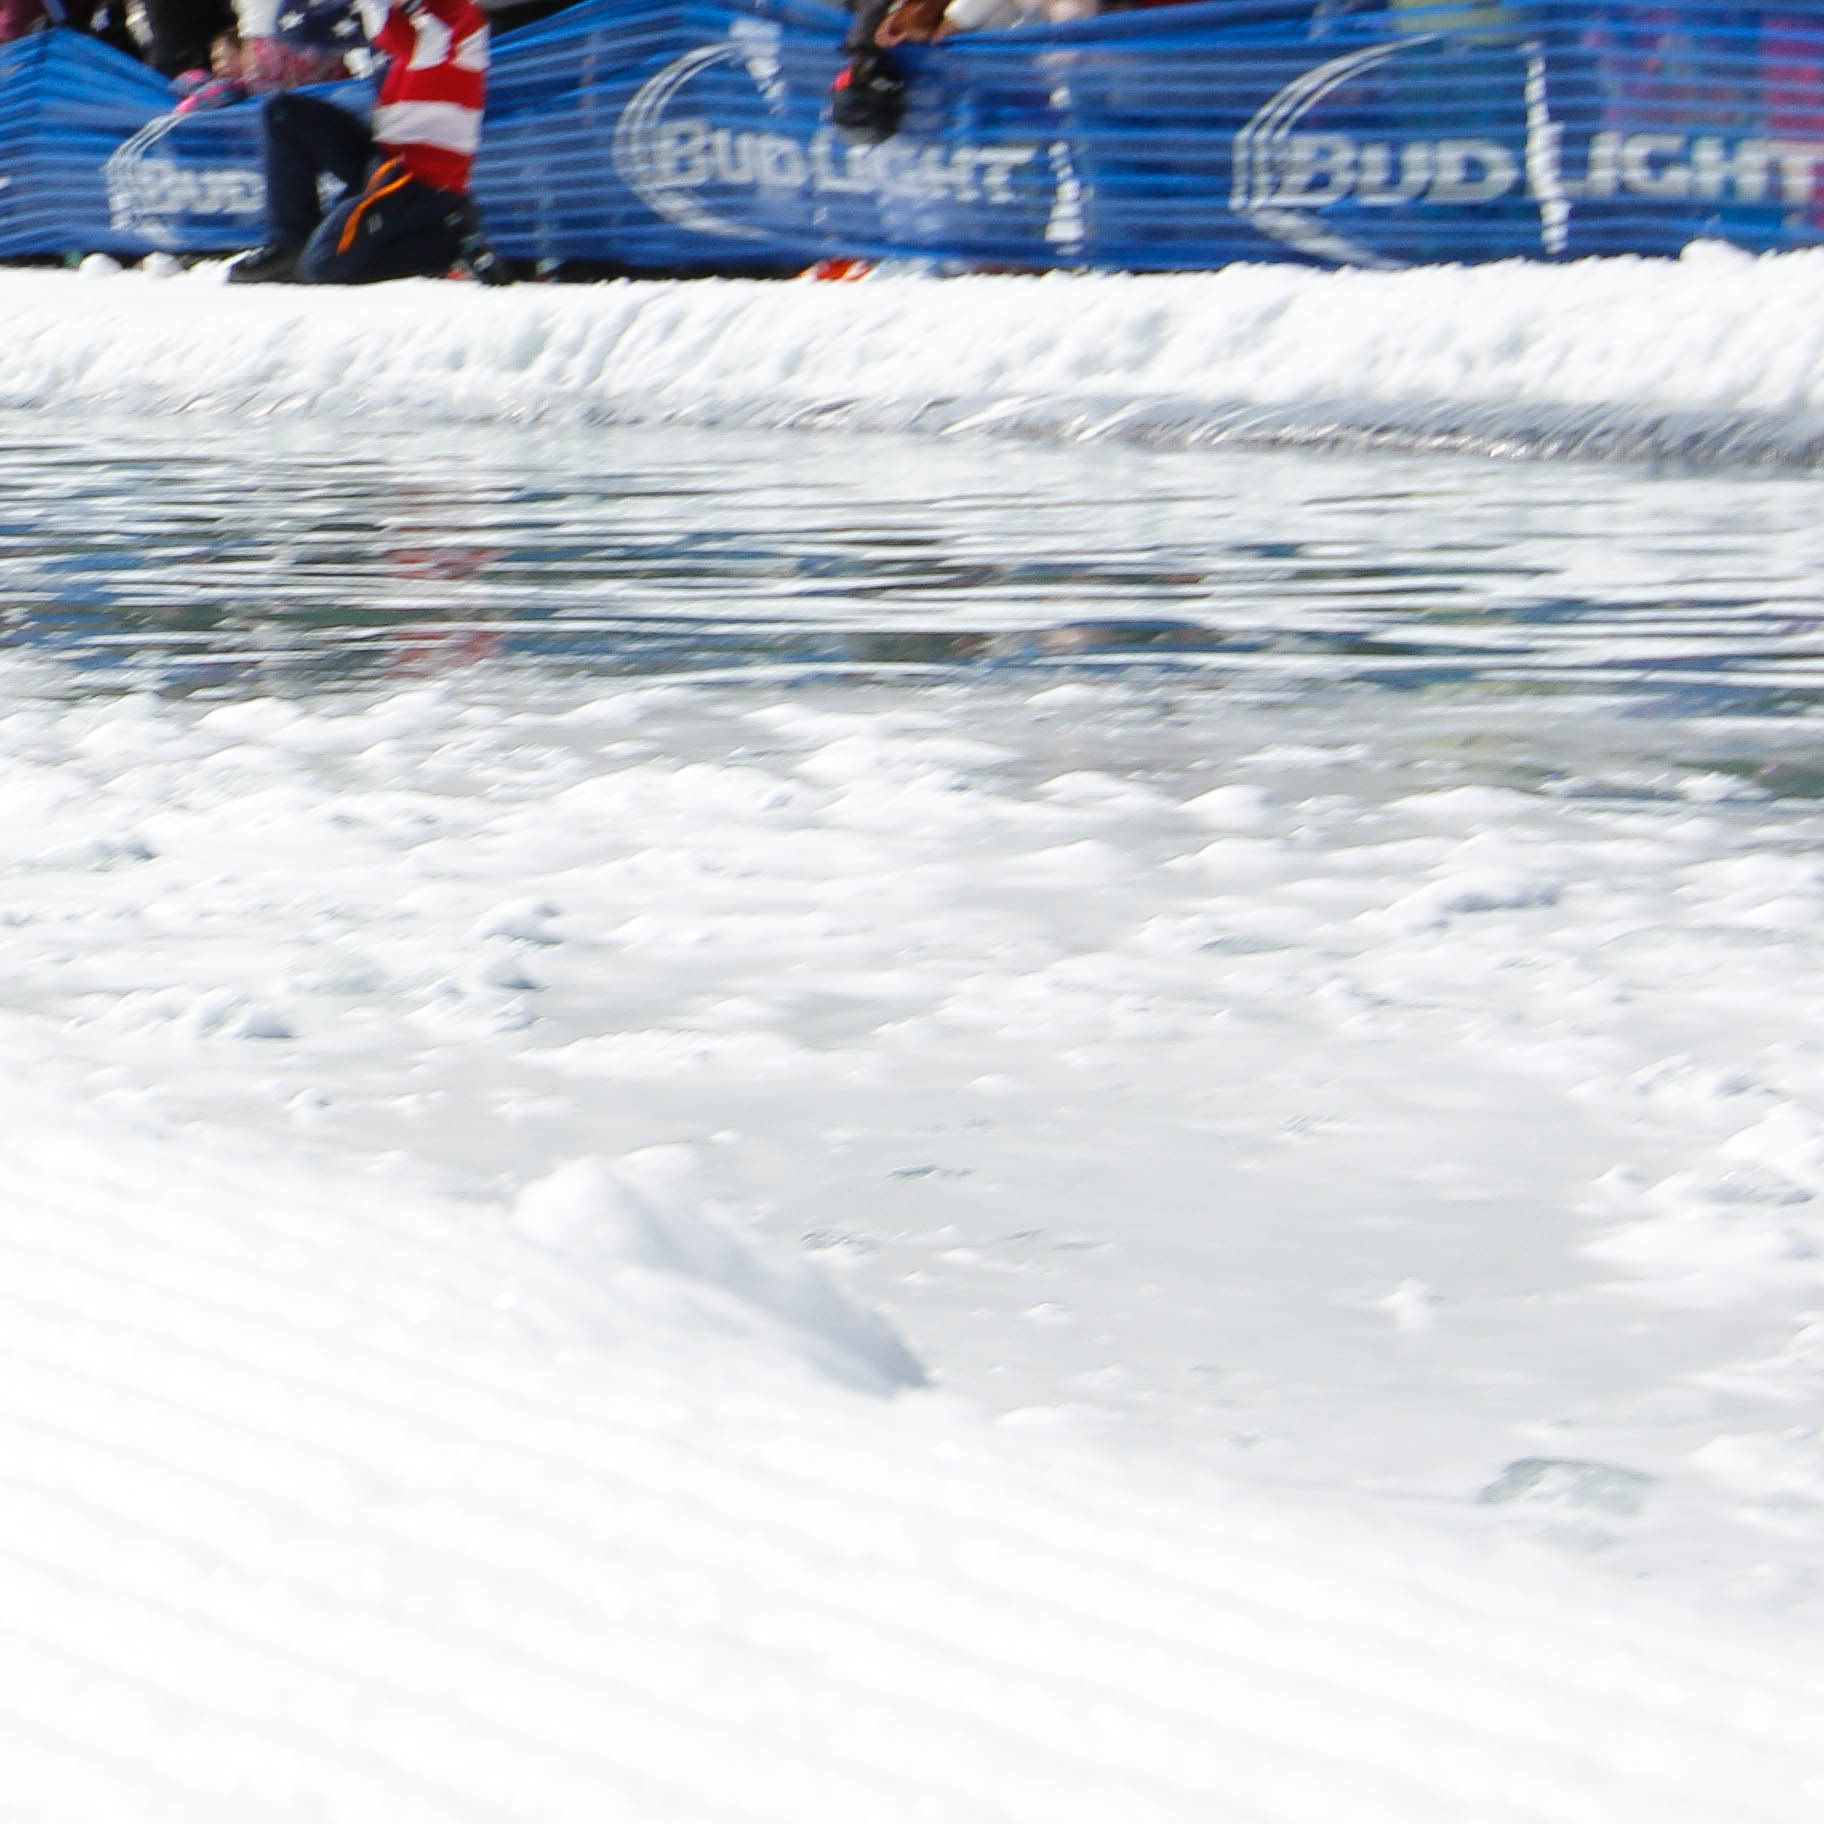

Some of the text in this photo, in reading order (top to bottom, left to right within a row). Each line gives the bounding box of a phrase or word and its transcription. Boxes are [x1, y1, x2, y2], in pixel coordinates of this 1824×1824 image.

[640, 118, 1037, 205] BUD LIGHT
[1257, 120, 1824, 210] BUD LIGHT
